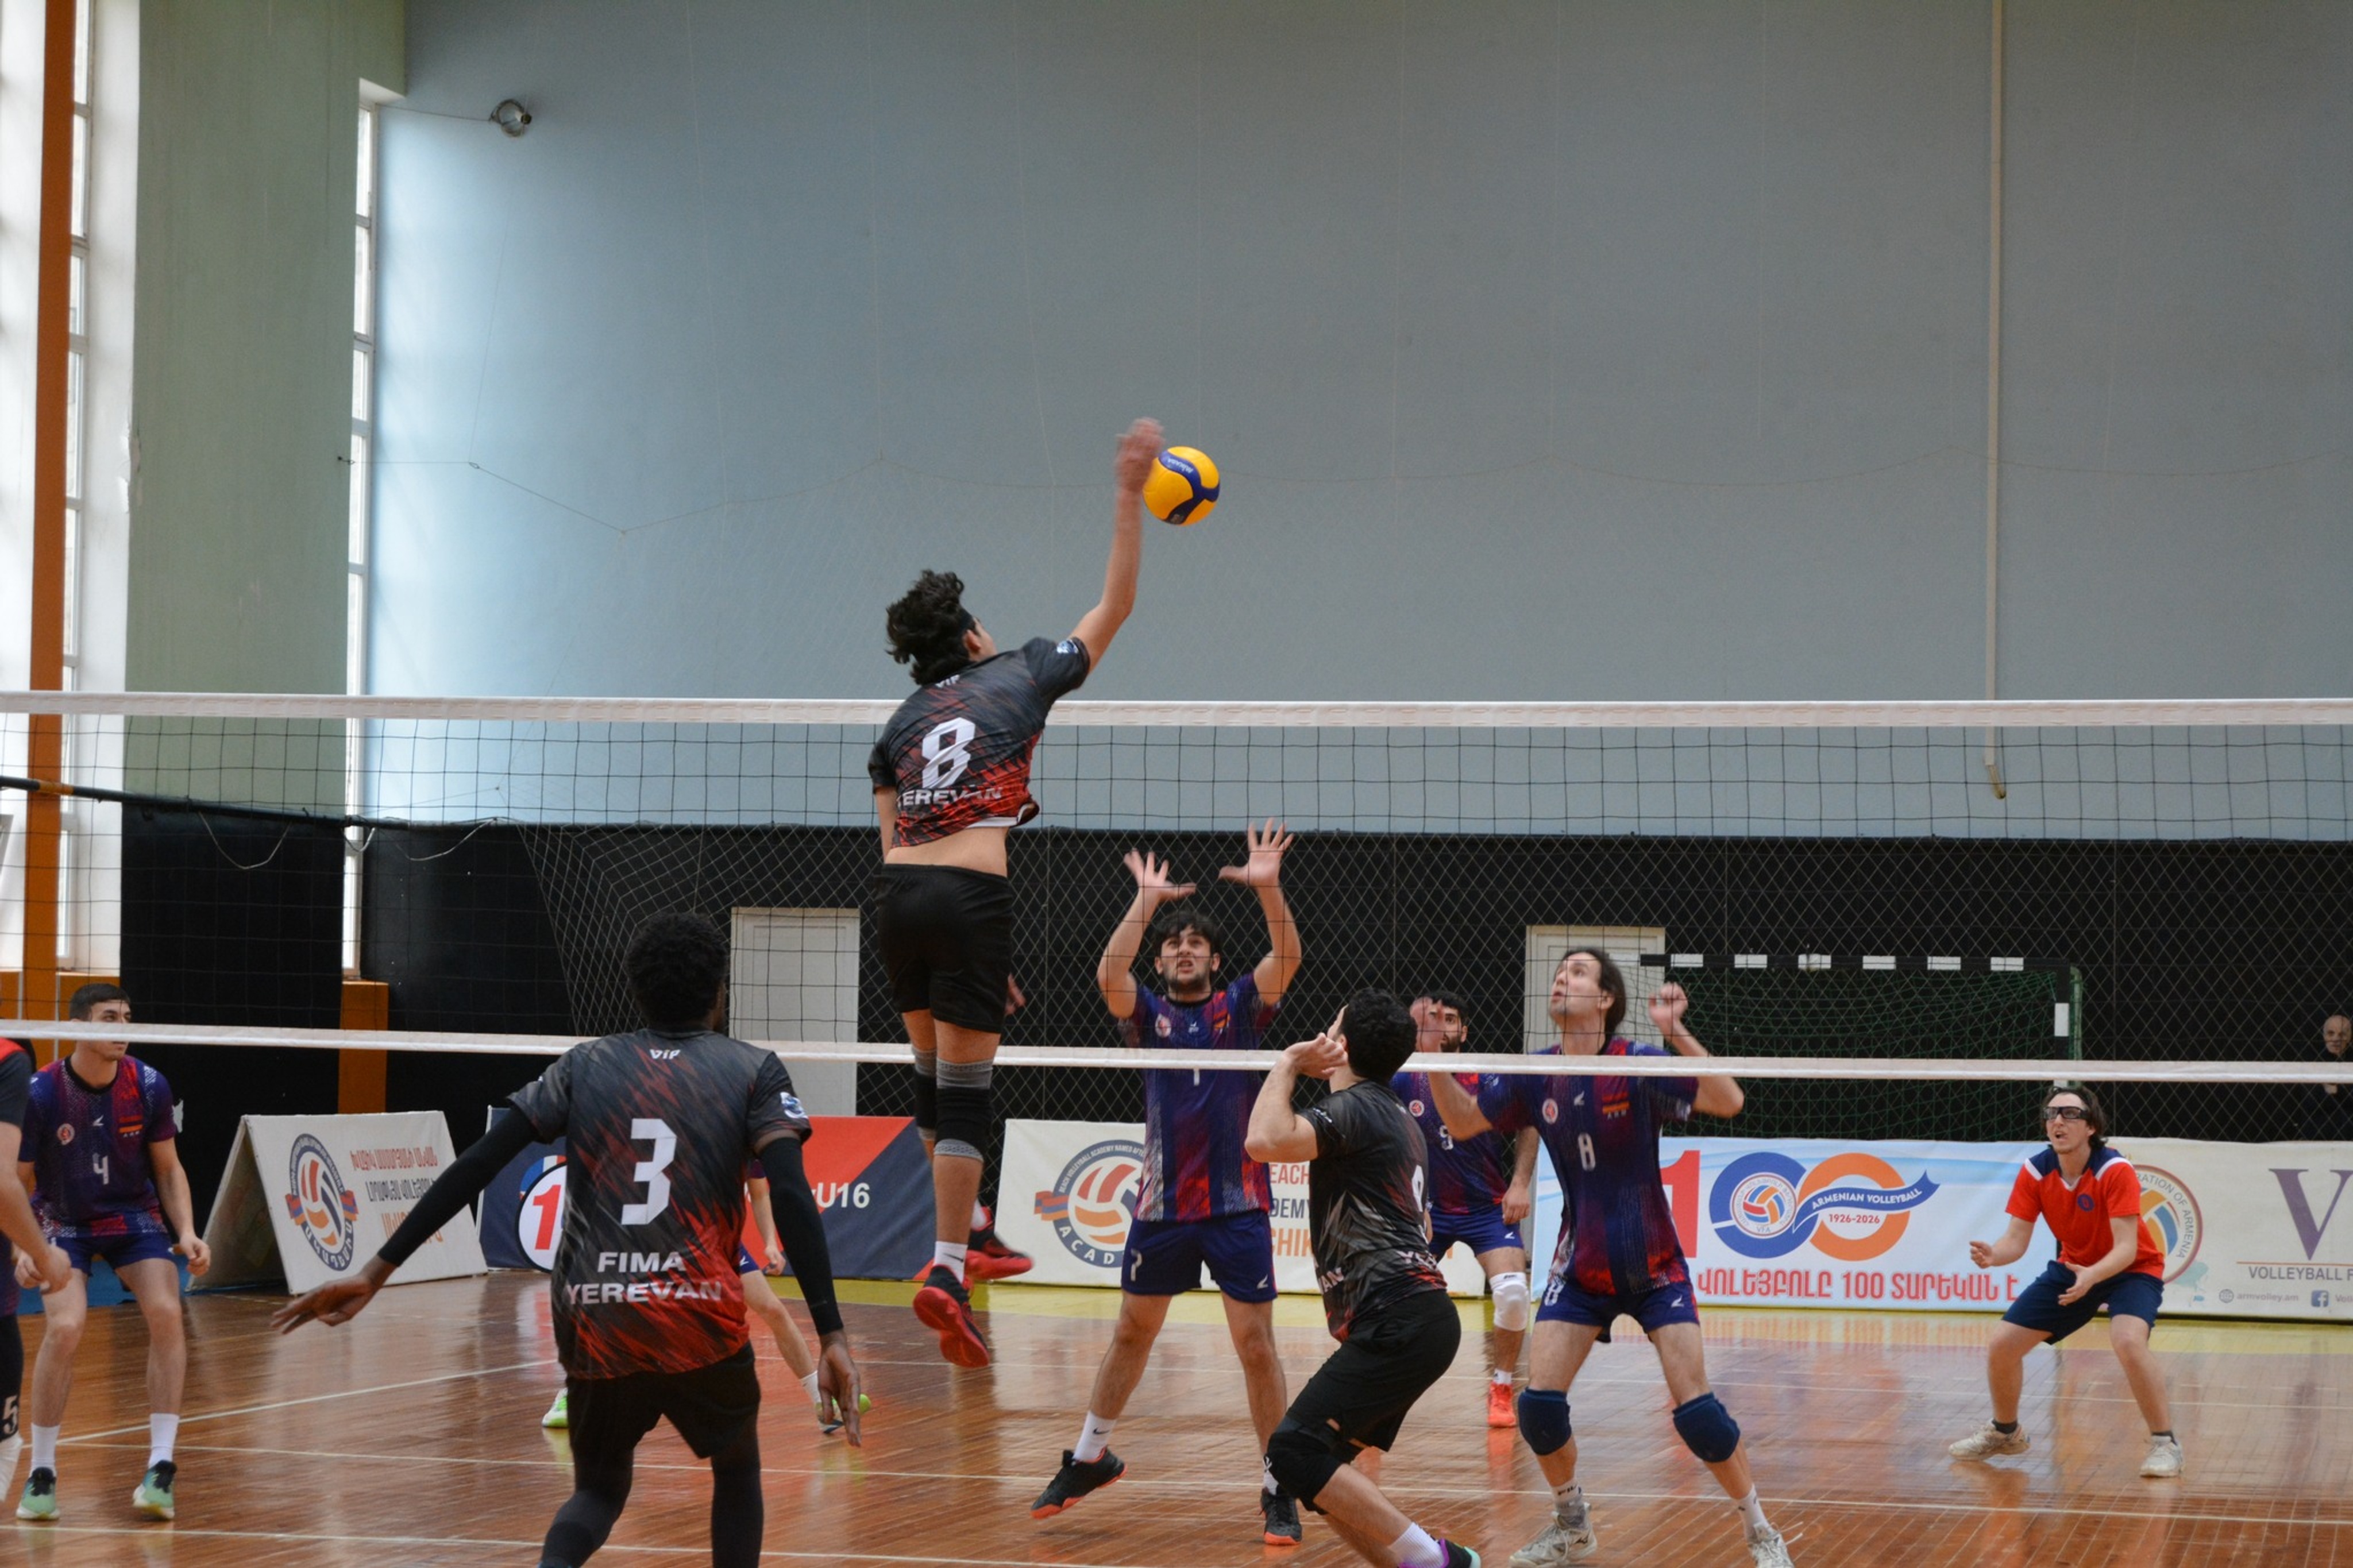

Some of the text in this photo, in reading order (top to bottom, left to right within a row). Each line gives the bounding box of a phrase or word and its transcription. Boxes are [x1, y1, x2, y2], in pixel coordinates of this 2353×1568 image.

[921, 717, 975, 789] 8
[1577, 1133, 1596, 1171] 8
[92, 1153, 110, 1185] 4
[621, 1118, 677, 1225] 3
[1270, 1163, 1310, 1185] EACH
[1812, 1188, 1923, 1210] ARMENIAN VOLLEYBALL
[2174, 1191, 2188, 1206] OF
[1829, 1214, 1880, 1224] 1926-2026
[2176, 1208, 2194, 1258] ARMENIA
[1059, 1225, 1115, 1265] ACAD
[597, 1252, 686, 1273] FIMA
[2248, 1266, 2343, 1280] VOLLEYBALL
[565, 1280, 722, 1305] YEREVAN
[1842, 1270, 1885, 1300] 100
[1891, 1272, 1999, 1301] ՏԱՐԵԿԱՆ
[2236, 1292, 2299, 1303] armvolley.am
[3, 1395, 18, 1435] 5
